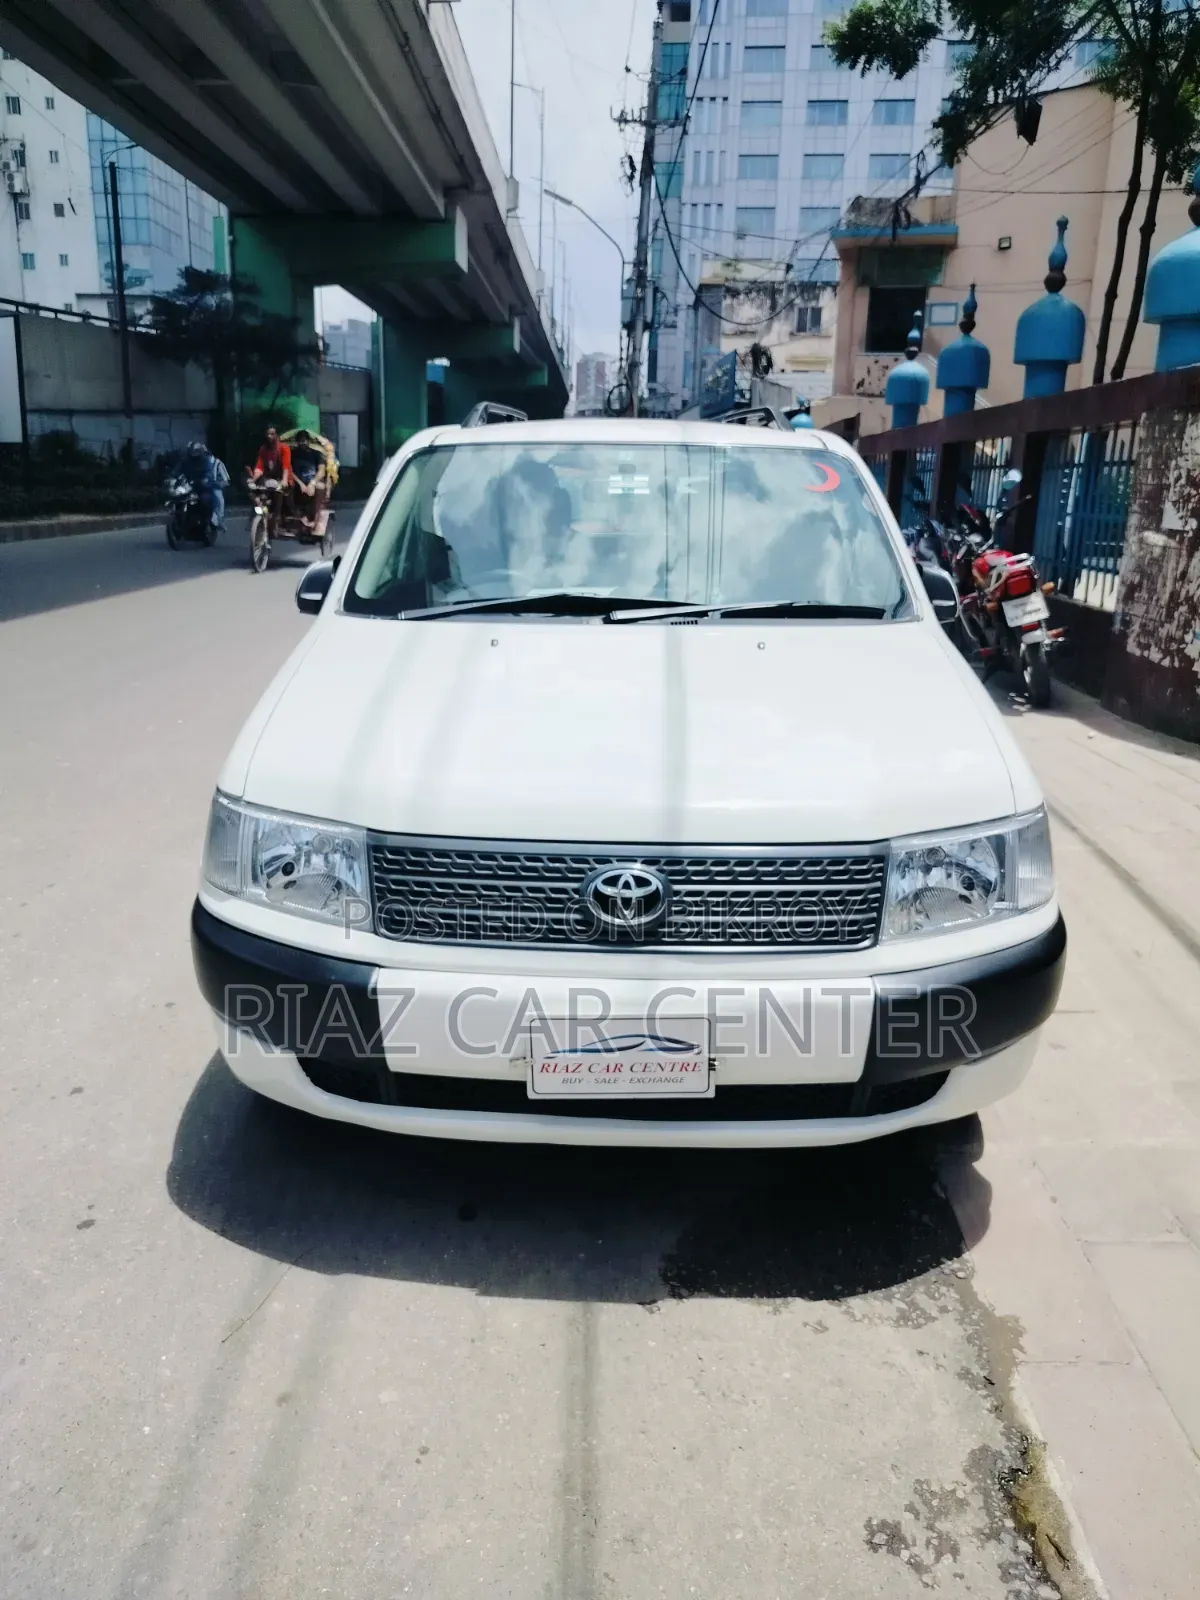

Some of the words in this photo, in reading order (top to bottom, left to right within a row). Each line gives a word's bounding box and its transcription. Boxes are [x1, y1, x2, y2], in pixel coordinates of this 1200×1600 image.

[539, 1062, 583, 1074] RIAZ
[588, 1062, 623, 1074] CAR
[629, 1061, 704, 1073] CENTRE
[629, 1076, 687, 1084] EXCHANGE
